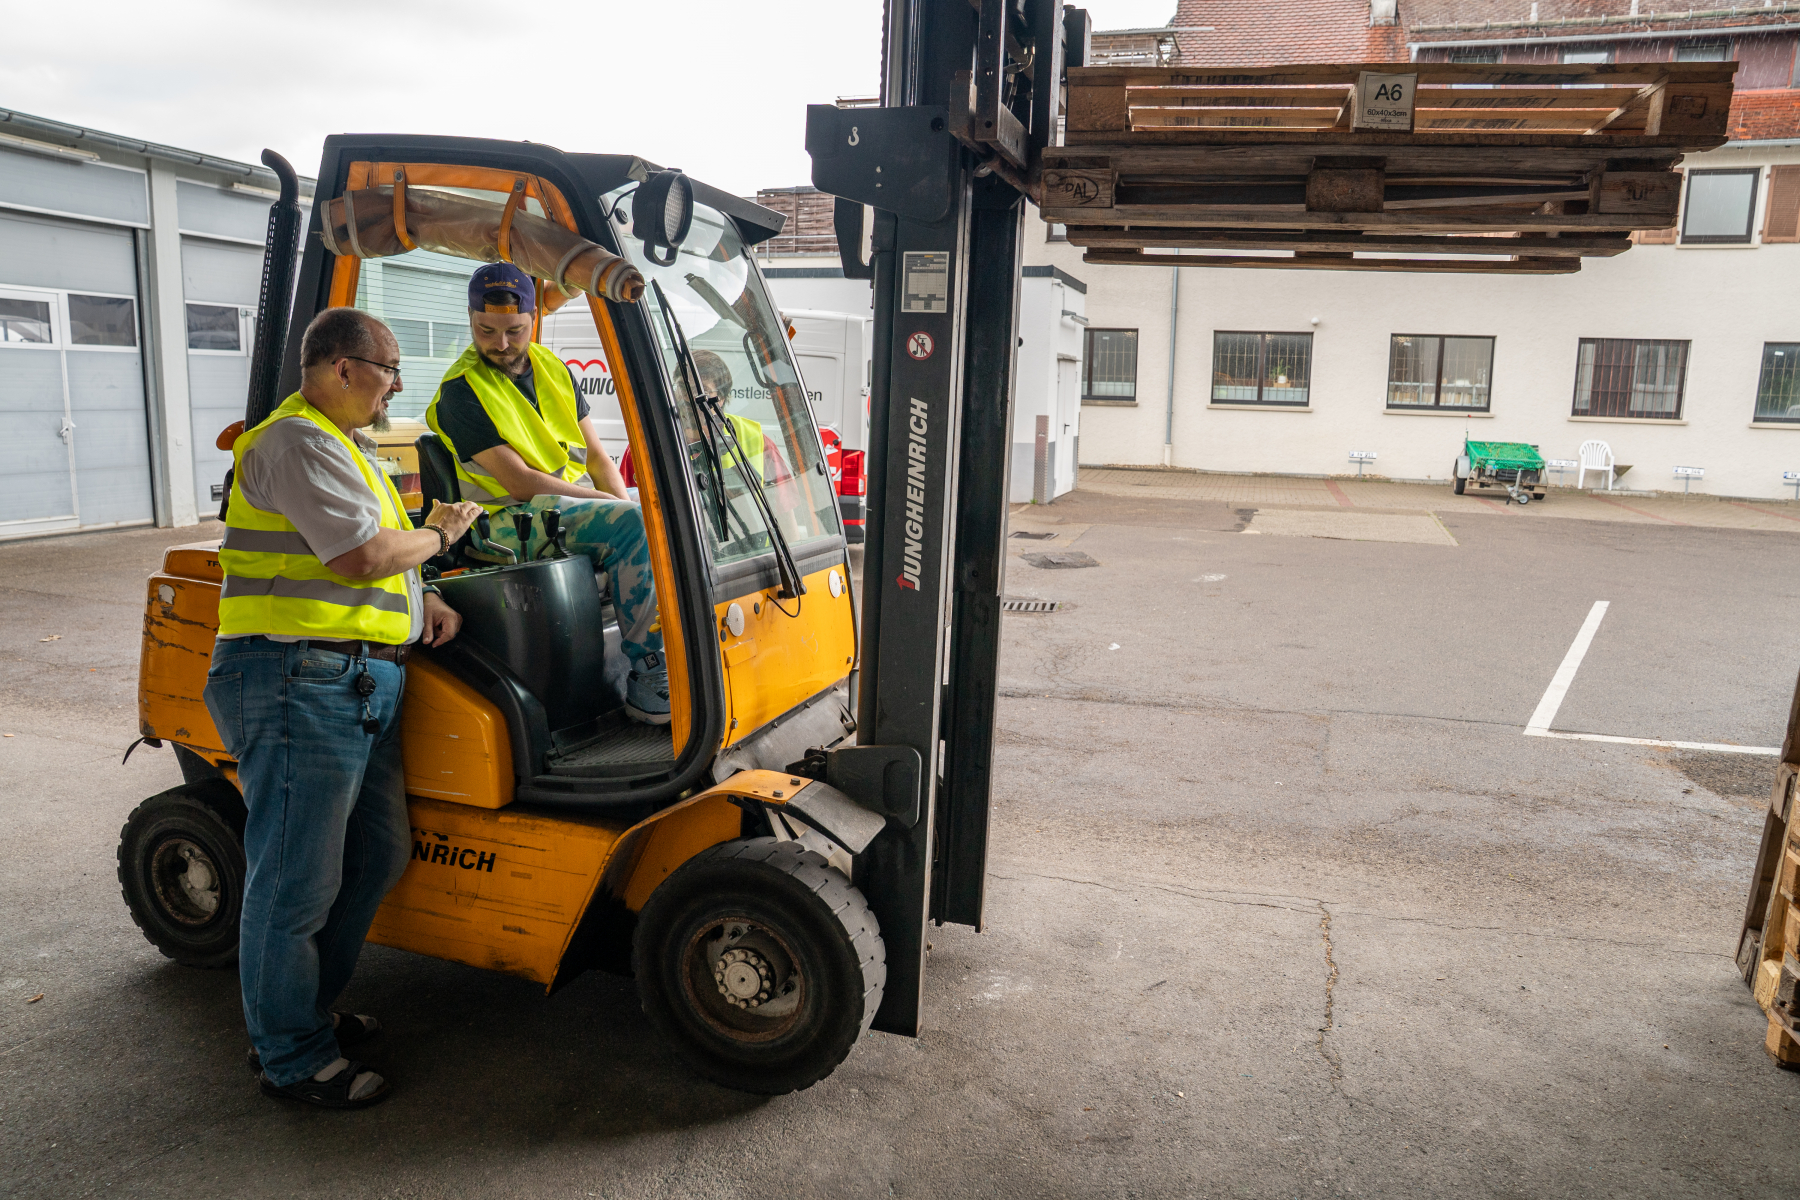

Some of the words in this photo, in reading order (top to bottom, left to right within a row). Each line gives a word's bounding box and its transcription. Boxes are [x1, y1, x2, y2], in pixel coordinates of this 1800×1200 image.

[1375, 84, 1403, 101] A6
[580, 377, 616, 395] AWO
[901, 397, 928, 591] JUNGHEINRICH
